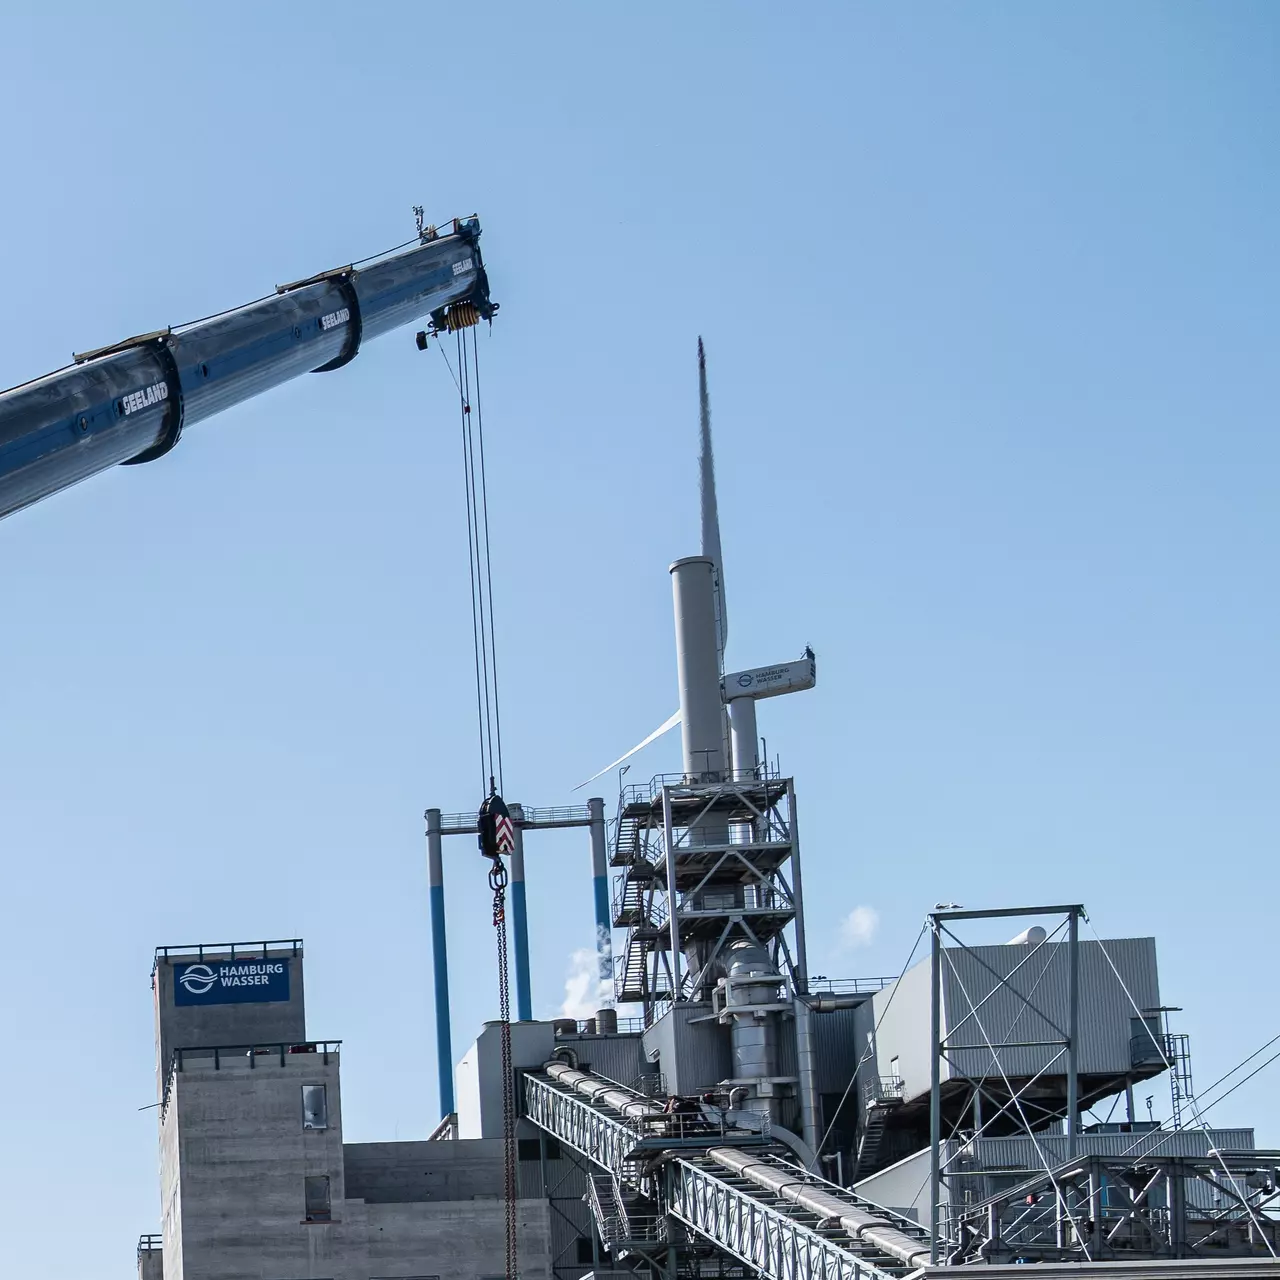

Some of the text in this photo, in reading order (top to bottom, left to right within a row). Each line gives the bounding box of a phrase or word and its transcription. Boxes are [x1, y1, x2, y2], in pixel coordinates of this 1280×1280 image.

[321, 308, 350, 331] SEELAND
[122, 381, 168, 416] SEELAND
[220, 964, 283, 977] HAMBURG
[220, 975, 269, 987] WASSER
